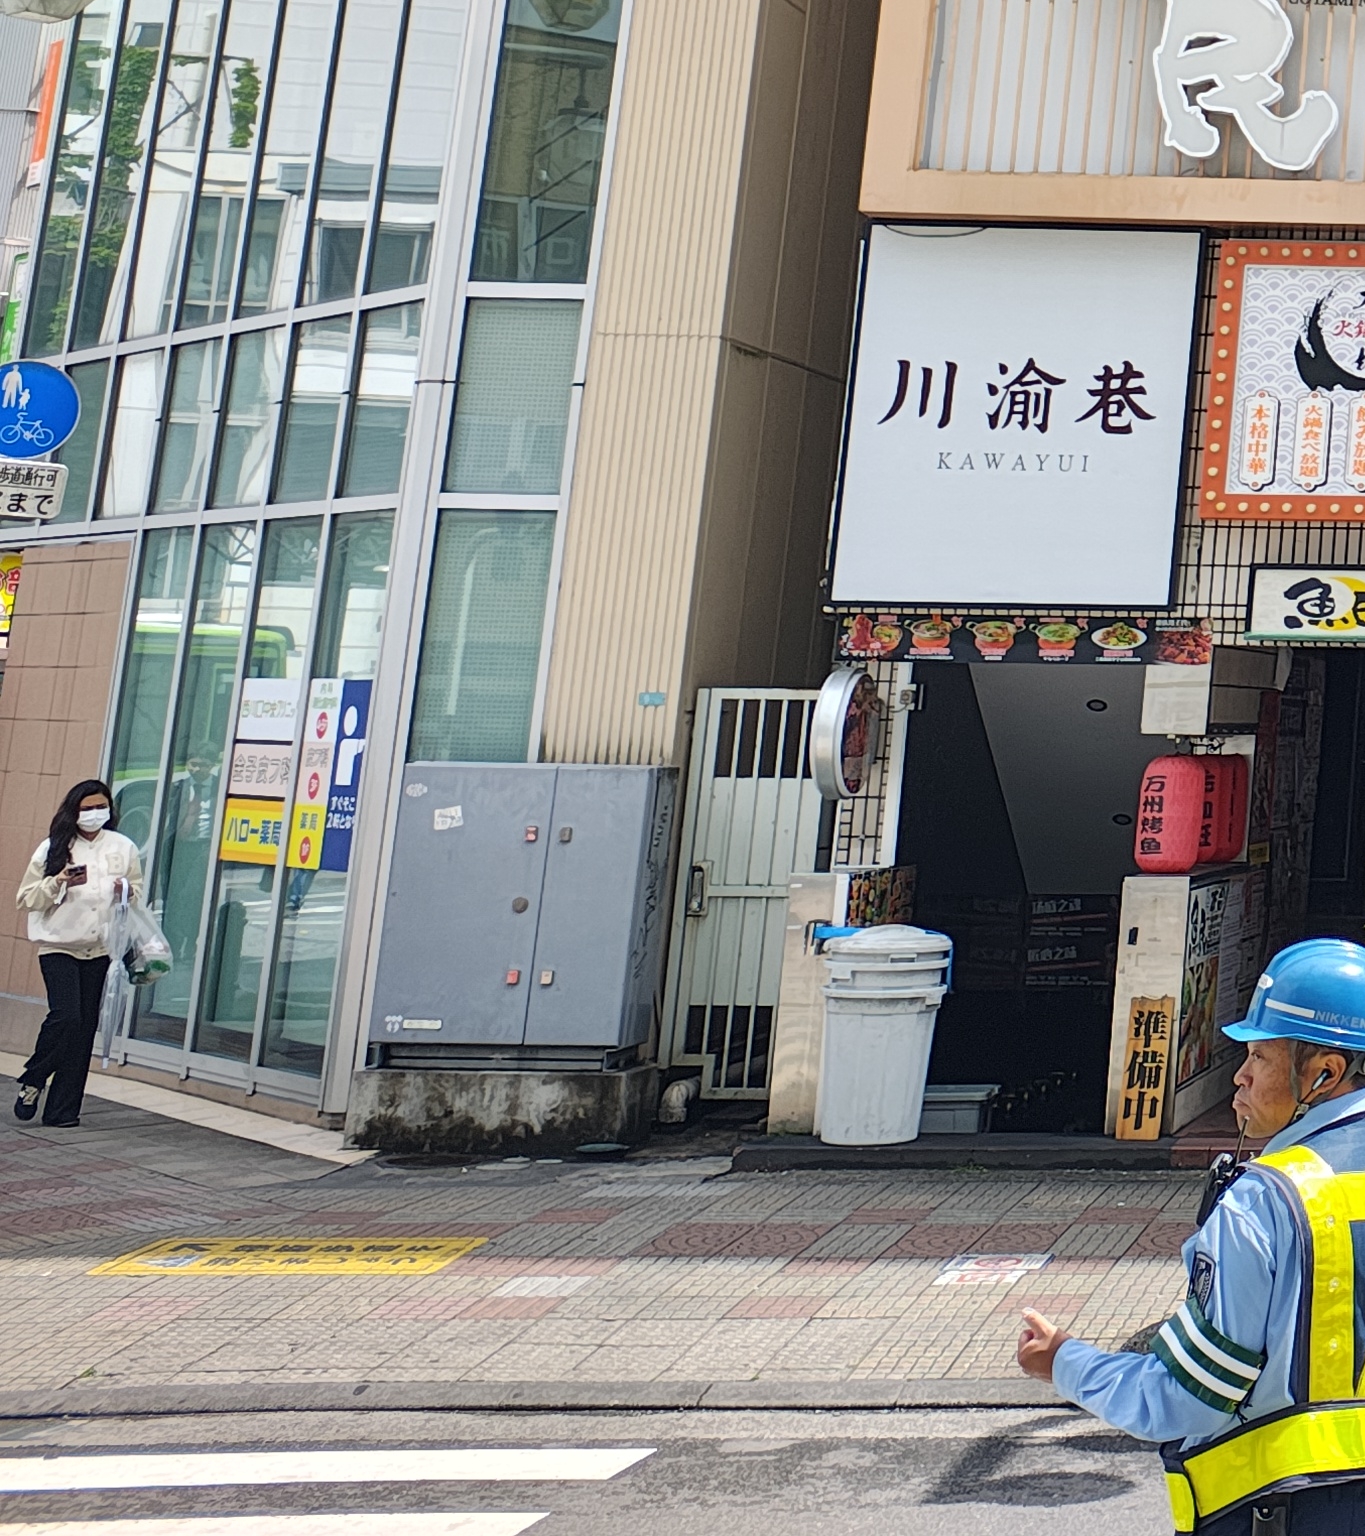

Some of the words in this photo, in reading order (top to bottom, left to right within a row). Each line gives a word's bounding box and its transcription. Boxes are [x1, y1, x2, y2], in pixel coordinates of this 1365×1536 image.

[877, 358, 1157, 435] 川渝巷
[937, 453, 1090, 473] KAWAYUI
[1247, 405, 1271, 475] 本格中華
[1300, 405, 1323, 477] 火鍋食べ放題
[105, 852, 125, 875] B
[1123, 1010, 1168, 1131] 準備中
